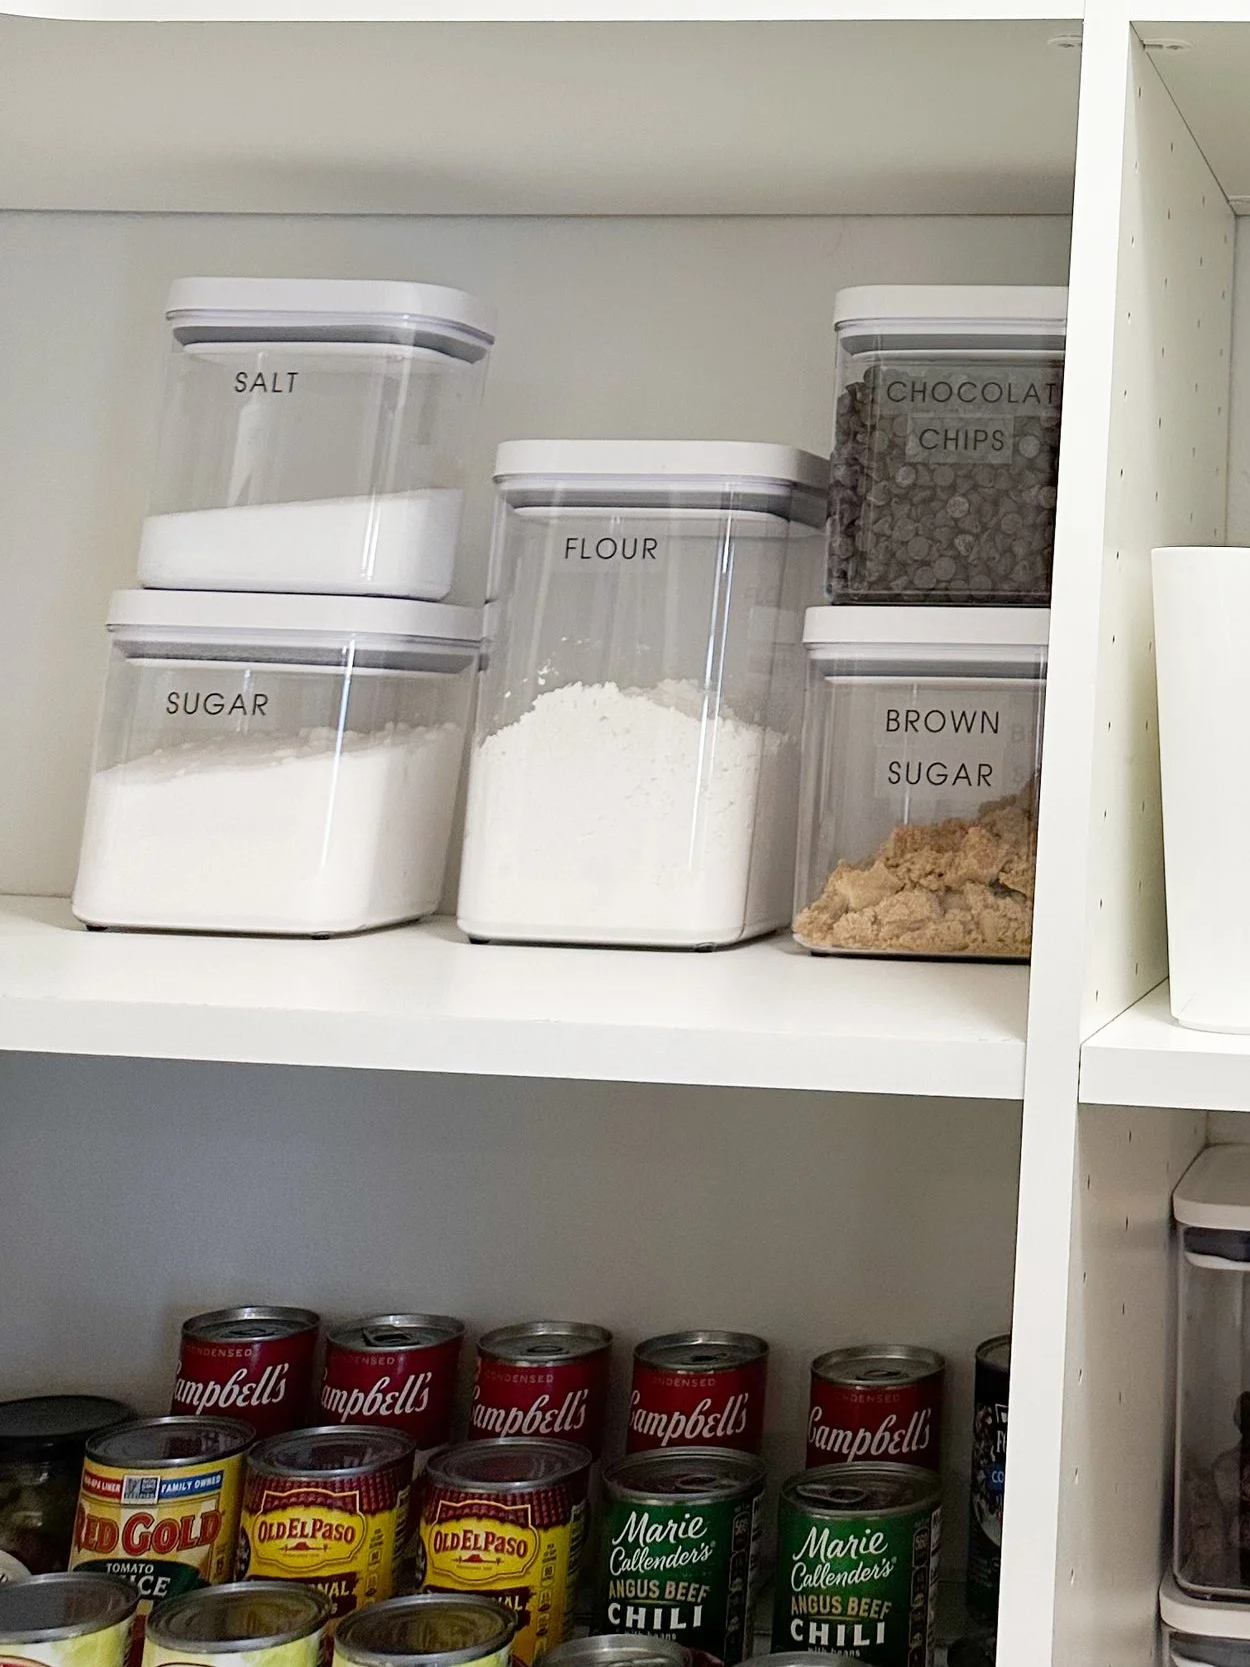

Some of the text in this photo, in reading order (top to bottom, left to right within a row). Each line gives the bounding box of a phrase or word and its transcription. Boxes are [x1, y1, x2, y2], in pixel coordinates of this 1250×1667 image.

[234, 371, 299, 394] SALT
[886, 380, 1057, 405] CHOCOLAT
[918, 428, 1005, 452] CHIPS
[564, 537, 659, 561] FLOUR
[166, 691, 269, 717] SUGAR
[885, 709, 1000, 735] BROWN
[887, 761, 993, 787] SUGAR
[321, 1367, 433, 1423] ampbell's
[808, 1405, 932, 1462] Campbell's
[160, 1482, 191, 1494] FAMILY
[194, 1475, 222, 1489] OWNED
[122, 1509, 222, 1556] GOLD
[258, 1519, 286, 1544] OLD
[288, 1517, 311, 1539] EL
[433, 1530, 460, 1554] OLD
[461, 1528, 482, 1552] EL
[611, 1510, 708, 1548] Marie
[792, 1525, 889, 1563] Marie
[106, 1562, 155, 1575] TOMATO
[609, 1542, 714, 1576] Callender's
[791, 1557, 894, 1592] Callender's
[608, 1578, 712, 1604] ANGUS BEEF
[607, 1601, 704, 1631] CHILI
[791, 1594, 893, 1620] ANGUS BEEF
[790, 1617, 886, 1647] CHILI
